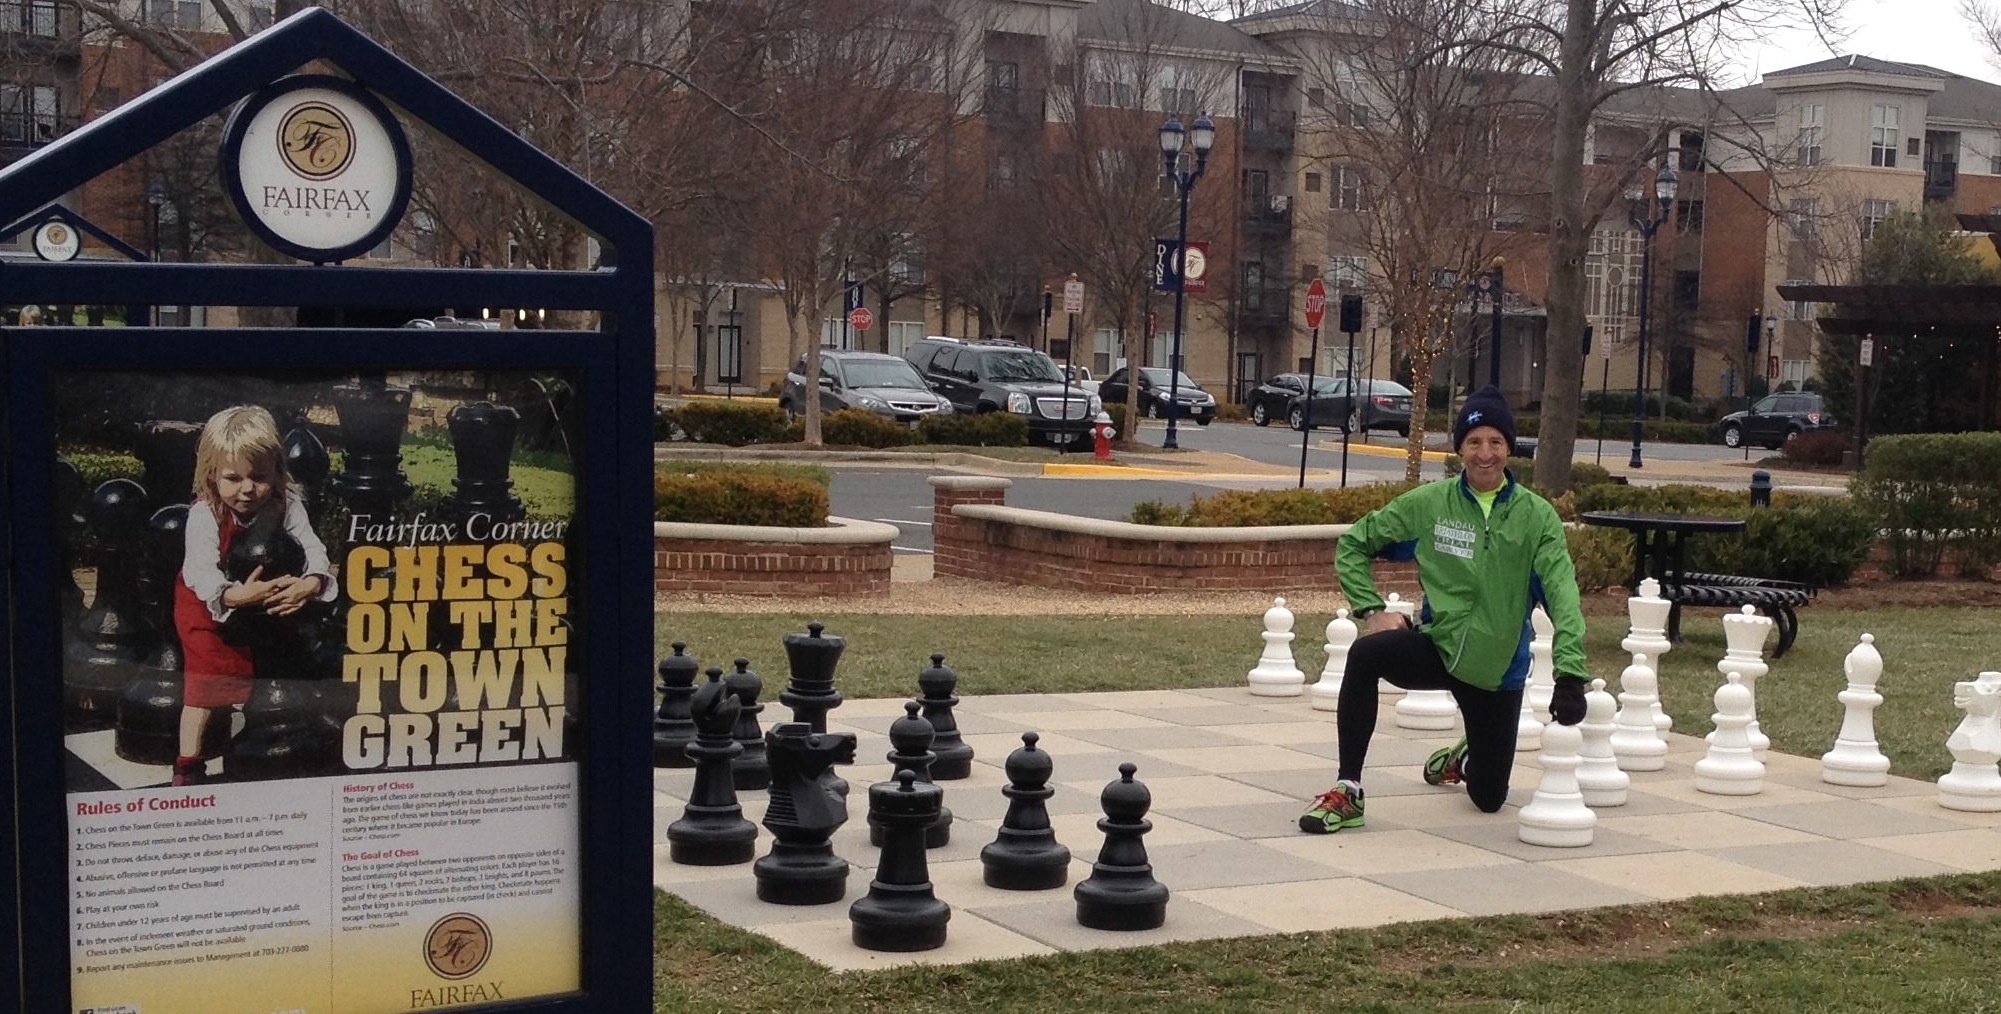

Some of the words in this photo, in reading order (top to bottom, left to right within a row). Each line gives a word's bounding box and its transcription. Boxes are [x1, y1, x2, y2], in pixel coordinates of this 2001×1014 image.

[262, 186, 371, 212] FAIRFAX
[1156, 244, 1166, 284] DINE
[1306, 294, 1324, 312] STOP
[852, 314, 870, 324] STOP
[346, 512, 458, 549] Fairfax
[466, 512, 568, 542] Corner
[1437, 516, 1474, 531] LANDAU
[346, 542, 567, 603] CHESS
[346, 602, 430, 654] ON
[450, 598, 568, 649] THE
[342, 646, 567, 714] TOWN
[342, 706, 566, 770] GREEN
[343, 784, 375, 793] History
[378, 782, 388, 790] of
[356, 795, 379, 804] origins
[476, 786, 498, 796] though
[76, 801, 122, 816] Rules
[126, 798, 144, 812] of
[149, 794, 216, 810] Conduct
[86, 826, 106, 834] Chess
[120, 824, 131, 832] the
[133, 823, 151, 831] Town
[153, 821, 174, 829] Green
[184, 817, 215, 827] available
[217, 817, 233, 825] from
[291, 810, 307, 820] daily
[85, 841, 106, 850] Chess
[108, 840, 130, 848] Pieces
[132, 838, 149, 846] must
[152, 836, 176, 845] remain
[189, 834, 198, 842] the
[202, 833, 222, 841] Chess
[224, 830, 244, 840] Board
[255, 829, 263, 837] all
[97, 857, 109, 865] not
[203, 848, 223, 857] abuse
[225, 848, 237, 856] any
[248, 845, 259, 853] the
[261, 844, 281, 852] Chess
[283, 840, 318, 852] equipment
[342, 853, 358, 861] The
[360, 850, 381, 860] Goal
[383, 850, 392, 858] of
[394, 848, 420, 857] Chess
[117, 870, 149, 879] offensive
[160, 867, 187, 878] profane
[189, 865, 221, 874] language
[244, 858, 277, 871] permitted
[287, 858, 299, 867] any
[363, 872, 397, 880] containing
[518, 860, 536, 870] player
[376, 863, 394, 872] game
[396, 859, 417, 870] played
[98, 887, 126, 897] animals
[127, 885, 155, 894] allowed
[168, 883, 180, 891] the
[182, 882, 202, 890] Chess
[203, 879, 224, 888] Board
[86, 906, 101, 915] Play
[112, 904, 127, 914] your
[146, 900, 159, 908] risk
[86, 921, 116, 930] Children
[118, 918, 138, 927] under
[151, 917, 169, 926] years
[180, 915, 193, 923] age
[195, 912, 212, 920] must
[224, 906, 260, 919] supervised
[282, 903, 300, 912] adult
[374, 901, 389, 910] king
[95, 936, 107, 945] the
[108, 935, 128, 943] event
[215, 923, 247, 934] saturated
[249, 920, 273, 932] ground
[86, 948, 107, 957] Chess
[121, 945, 132, 954] the
[134, 944, 152, 952] Town
[154, 942, 175, 950] Green
[177, 939, 189, 948] will
[191, 939, 203, 947] not
[215, 934, 246, 945] available
[86, 963, 110, 974] Report
[112, 963, 124, 972] any
[127, 959, 173, 969] maintenance
[206, 950, 251, 962] Management
[410, 980, 504, 1008] FAIRFAX
